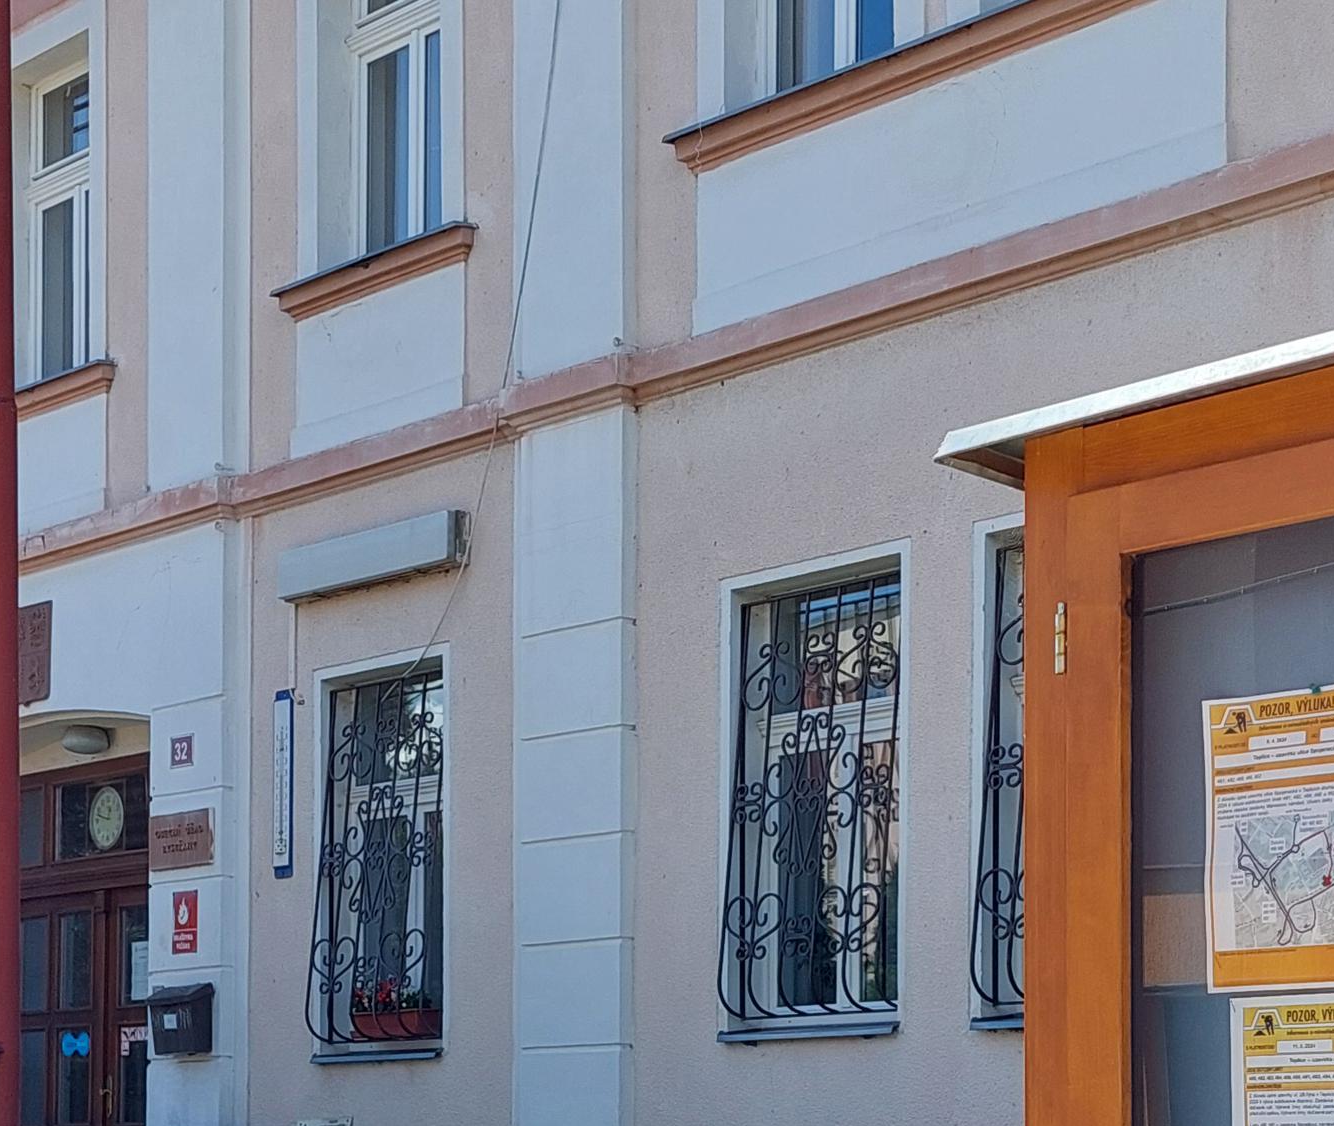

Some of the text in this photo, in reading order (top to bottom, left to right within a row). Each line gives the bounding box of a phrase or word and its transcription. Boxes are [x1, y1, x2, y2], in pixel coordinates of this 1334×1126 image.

[1259, 696, 1334, 718] POZOR, VÝLUKA!
[174, 742, 188, 761] 32
[1286, 1010, 1319, 1023] POZOR,
